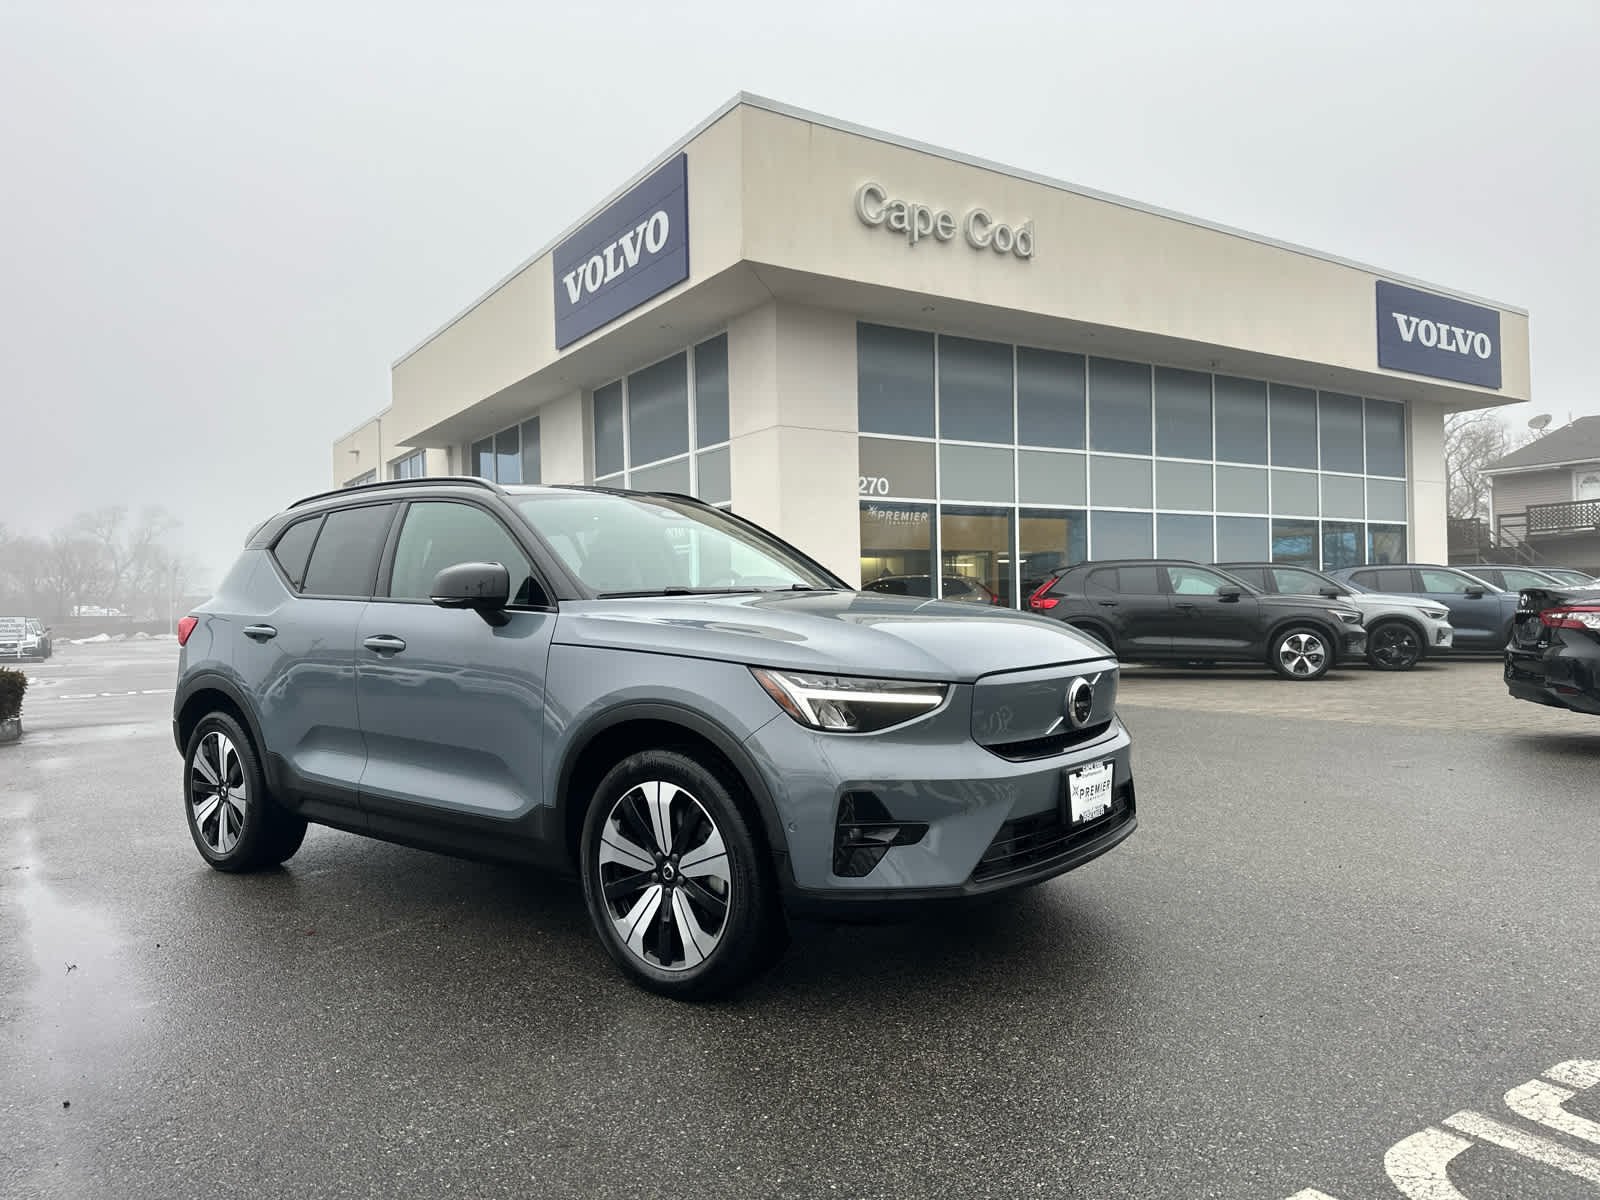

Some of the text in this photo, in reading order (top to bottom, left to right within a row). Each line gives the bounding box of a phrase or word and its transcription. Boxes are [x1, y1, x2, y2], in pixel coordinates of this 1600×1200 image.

[856, 182, 1036, 259] Cape Cod
[562, 209, 670, 305] VOLVO
[1391, 312, 1492, 360] VOLVO
[858, 476, 889, 495] 270
[877, 510, 929, 522] PREMIER
[1079, 779, 1111, 800] PREMIER
